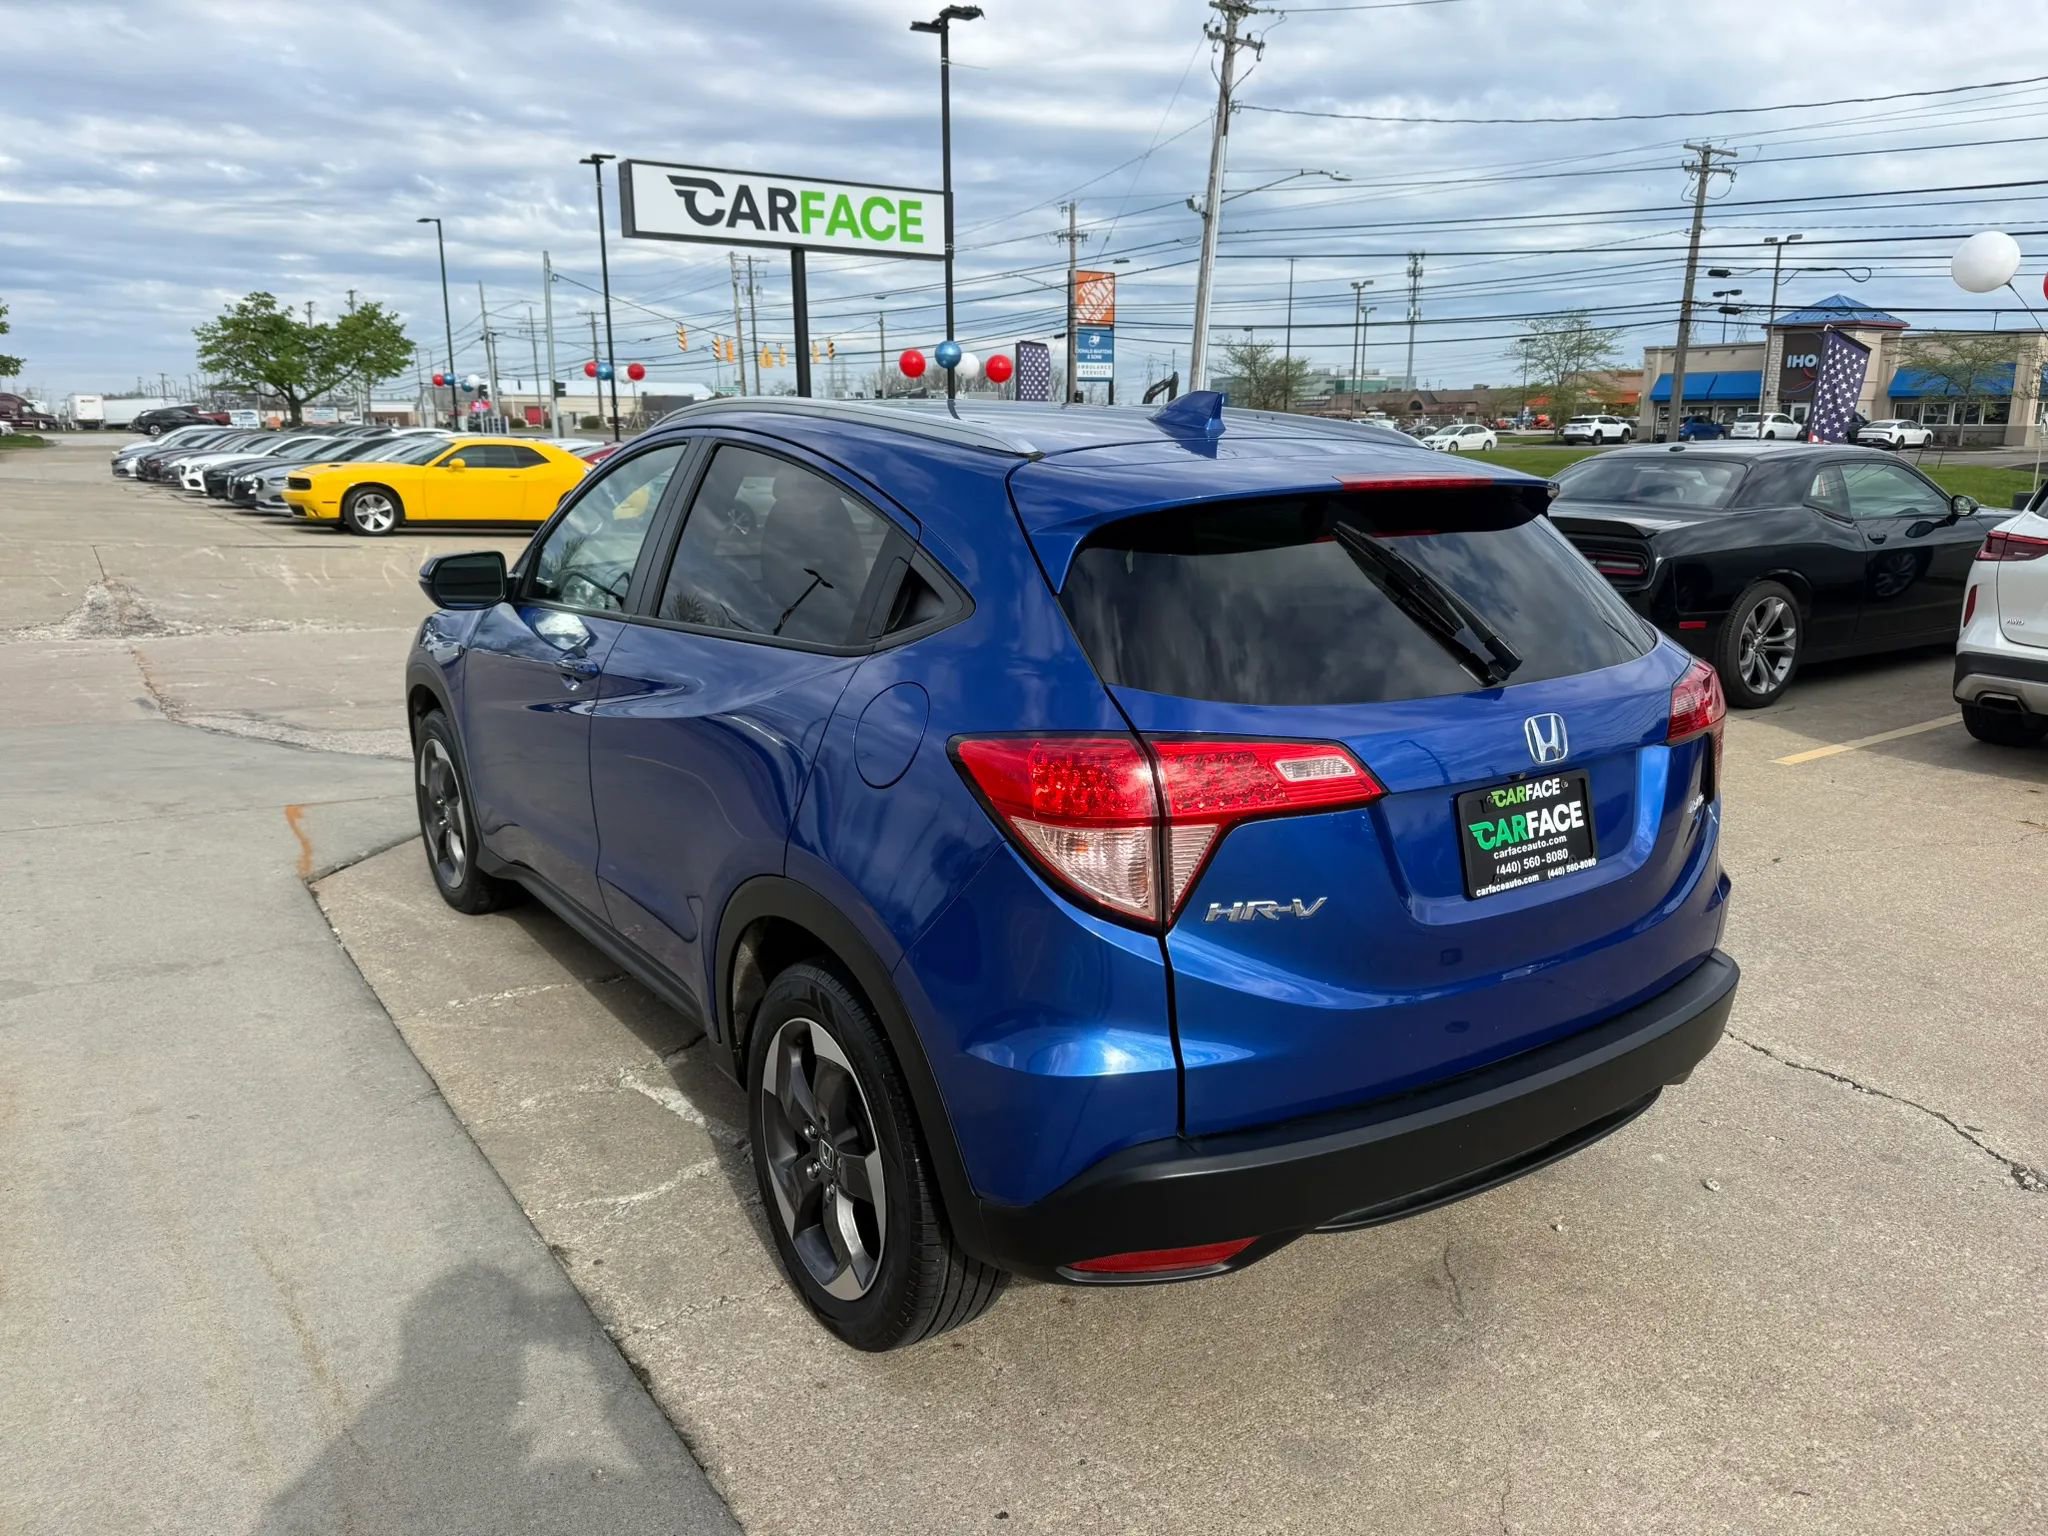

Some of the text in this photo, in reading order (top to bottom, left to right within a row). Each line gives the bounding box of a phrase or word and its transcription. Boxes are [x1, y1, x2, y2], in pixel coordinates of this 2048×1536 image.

[667, 174, 924, 243] CARFACE
[1787, 354, 1819, 369] IHO
[1491, 777, 1561, 807] CARFACE
[1468, 800, 1584, 850] CARFACE
[1493, 835, 1567, 859] carfaceauto.com
[1476, 874, 1539, 897] carfaceauto.com
[1547, 866, 1565, 879] (440)
[1496, 860, 1521, 875] (440)
[1204, 896, 1328, 922] HR-V
